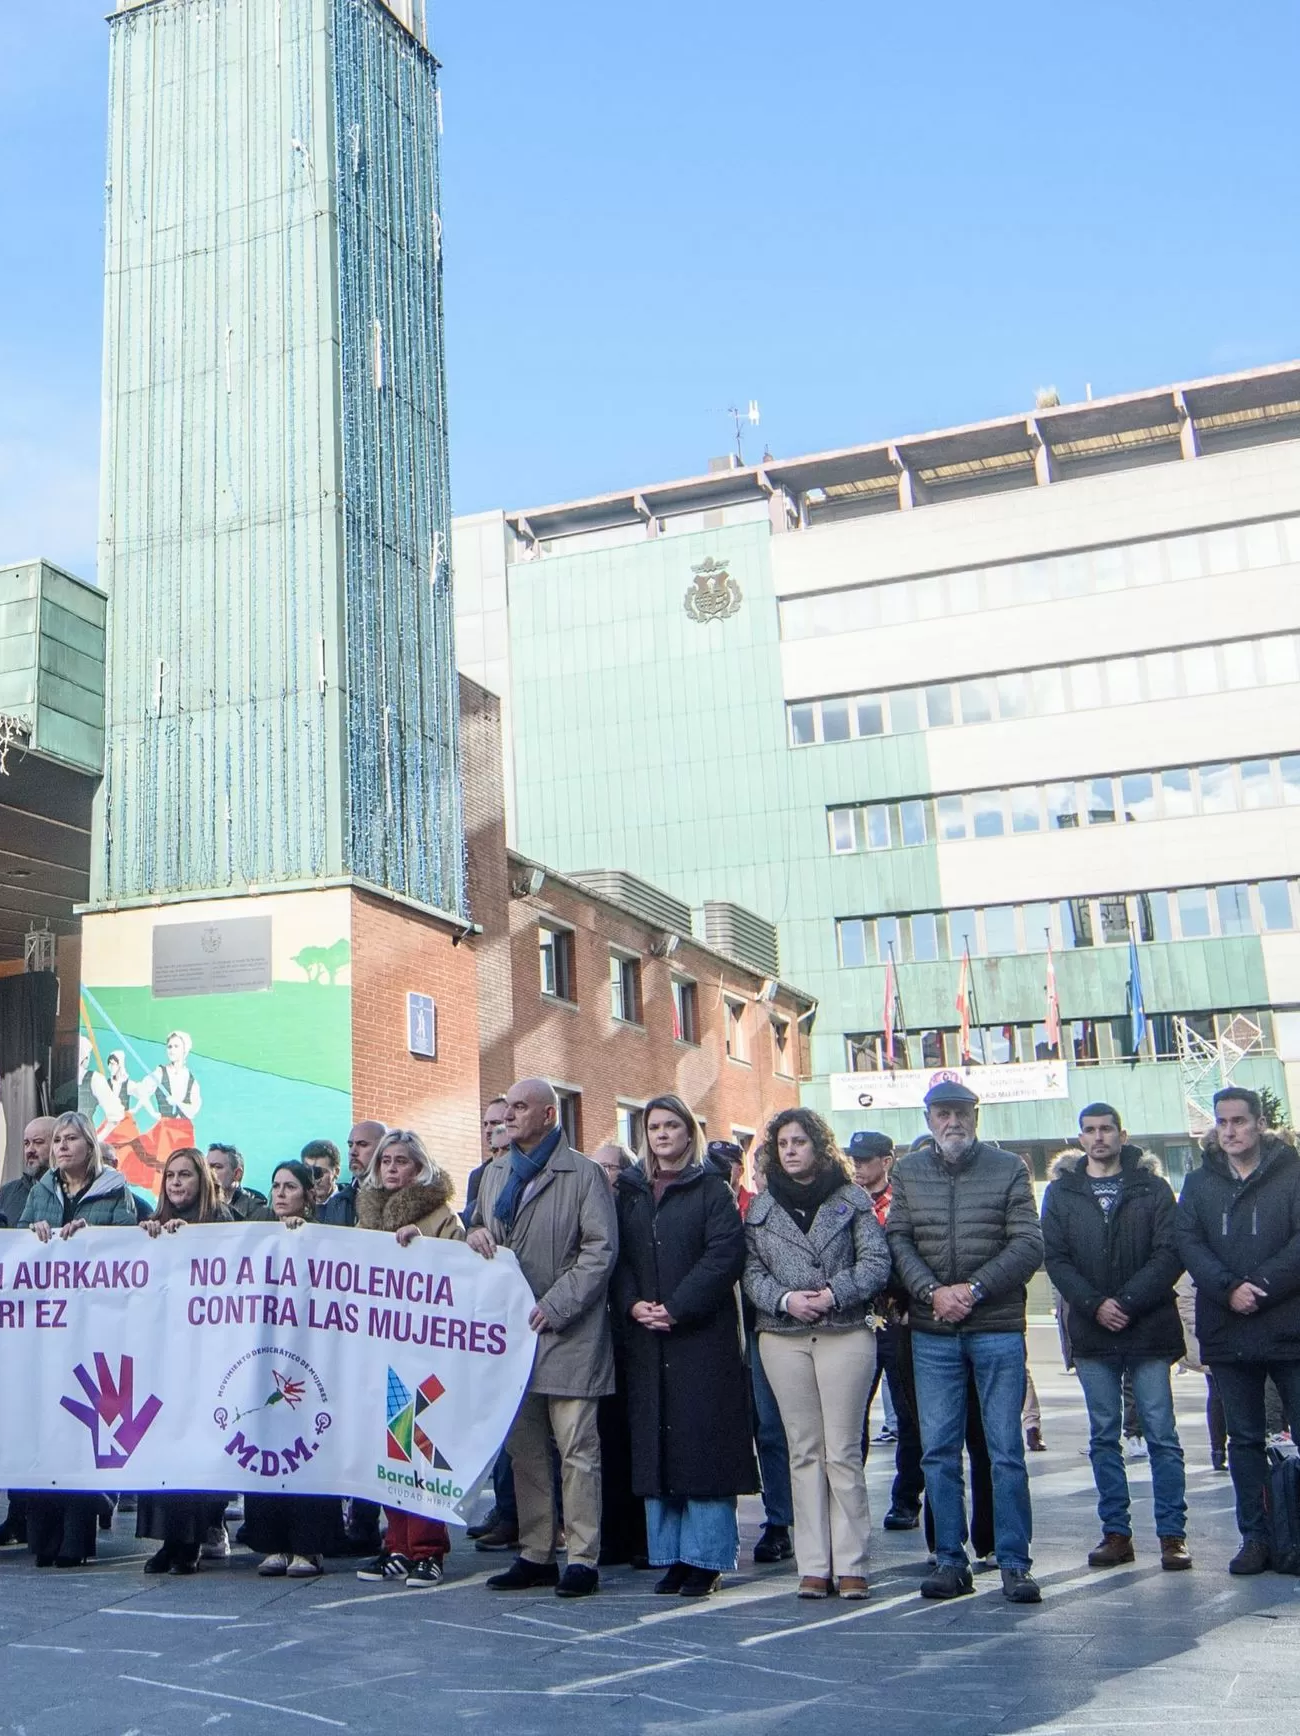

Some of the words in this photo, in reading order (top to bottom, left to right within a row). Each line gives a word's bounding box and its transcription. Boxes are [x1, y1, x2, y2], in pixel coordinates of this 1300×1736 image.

[13, 1260, 149, 1290] AURKAKO
[190, 1257, 227, 1286] NO
[236, 1256, 254, 1285] A
[265, 1256, 297, 1286] LA
[308, 1259, 454, 1307] VIOLENCIA
[35, 1300, 68, 1328] EZ
[188, 1295, 298, 1327] CONTRA
[308, 1299, 359, 1334] LAS
[368, 1307, 507, 1356] MUJERES
[218, 1353, 253, 1398] MOVIMIENTO
[300, 1359, 310, 1371] DE
[308, 1368, 328, 1404] MUJERES
[224, 1430, 319, 1477] M.D.M.
[377, 1464, 464, 1498] Barakaldo
[387, 1486, 423, 1501] CIUDAD
